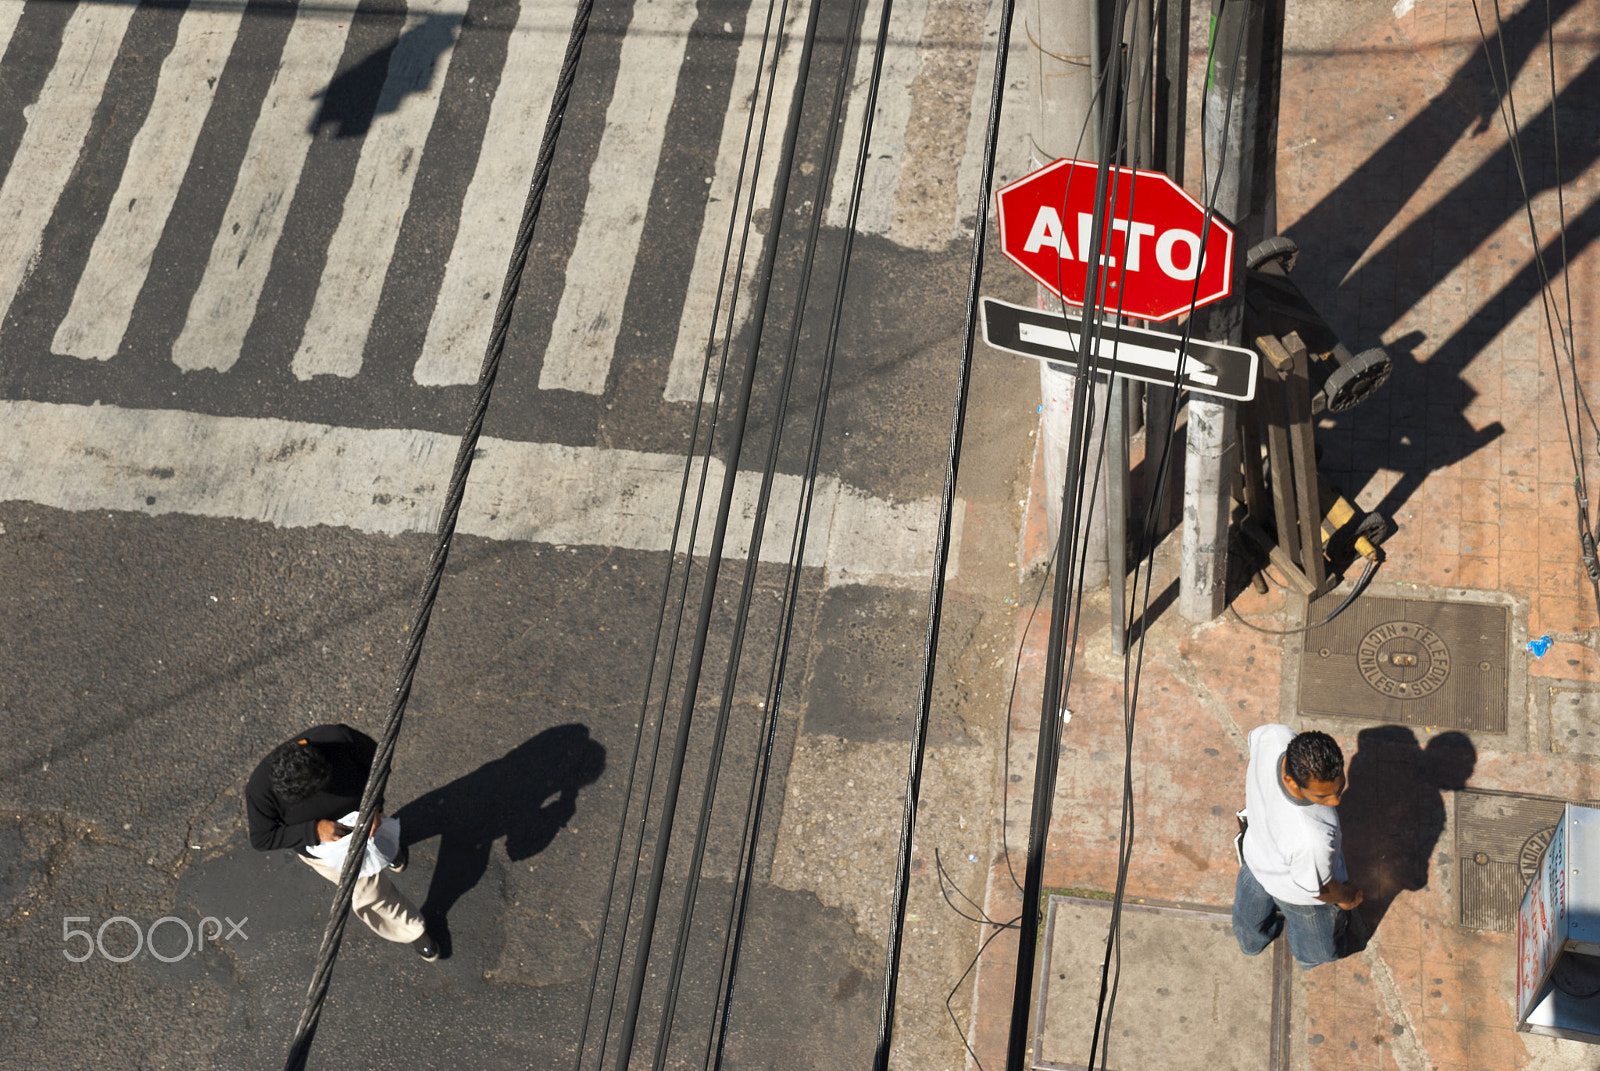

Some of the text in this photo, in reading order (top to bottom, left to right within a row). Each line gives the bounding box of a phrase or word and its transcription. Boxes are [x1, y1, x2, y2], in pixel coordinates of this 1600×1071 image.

[1023, 205, 1207, 281] ALTO
[1360, 624, 1398, 693] NACIONALES
[1411, 626, 1448, 696] TELEFONOS
